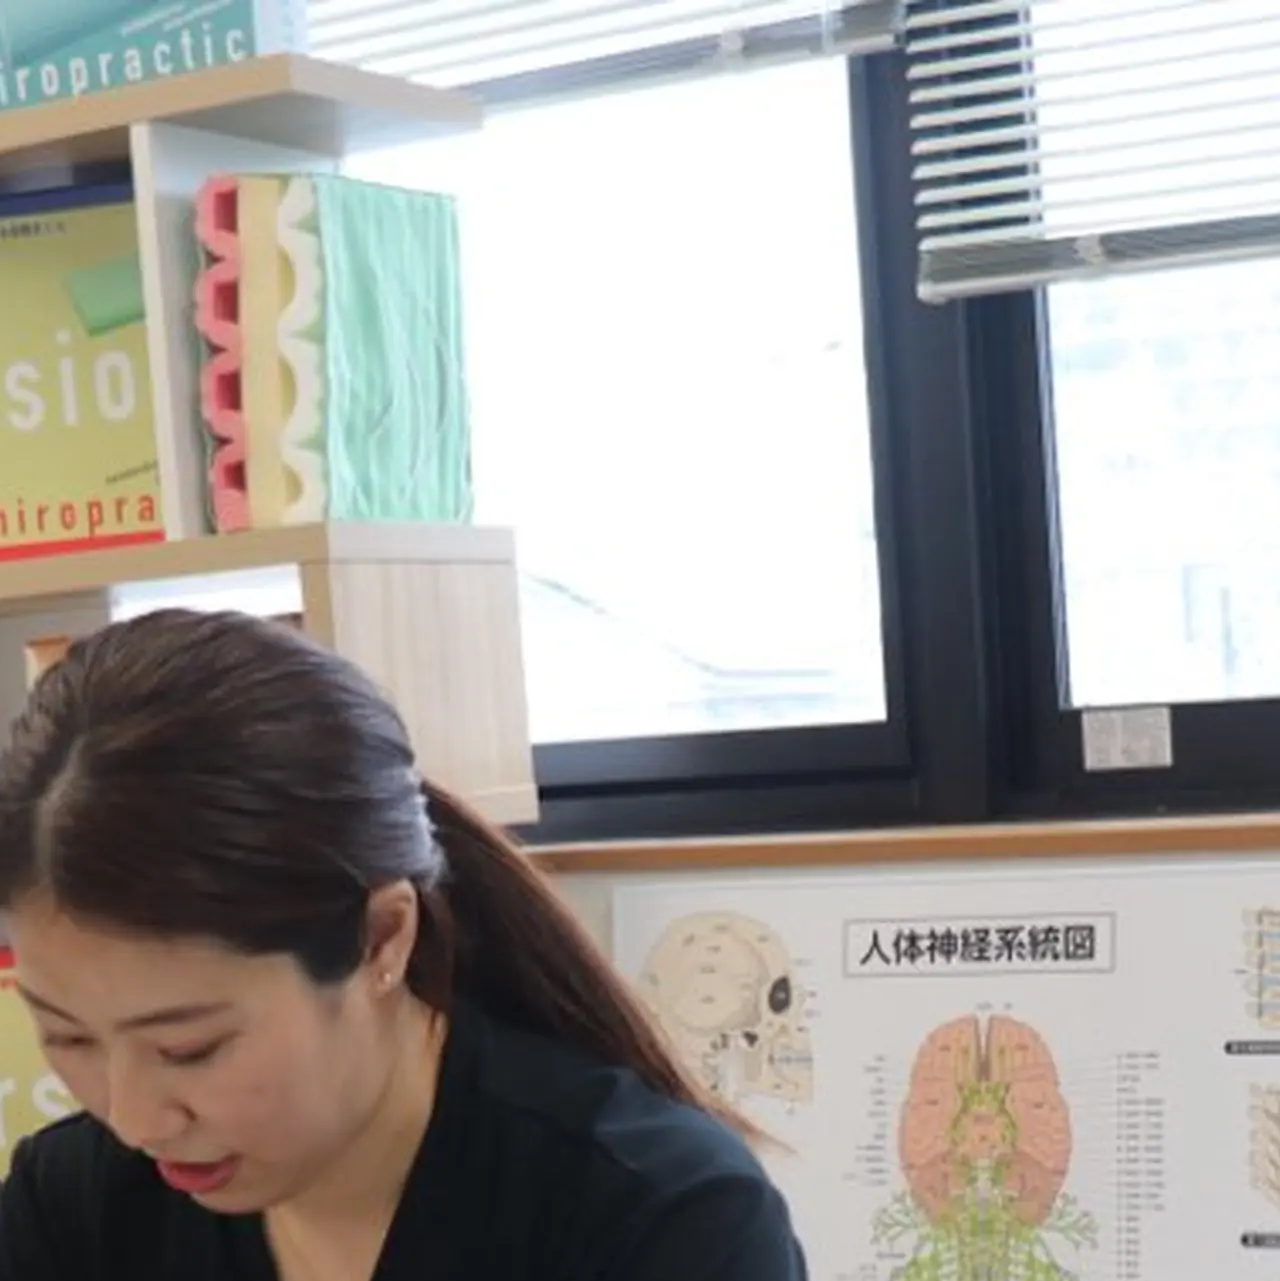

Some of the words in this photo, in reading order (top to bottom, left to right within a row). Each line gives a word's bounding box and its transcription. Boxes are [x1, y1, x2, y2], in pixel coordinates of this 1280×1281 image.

[859, 922, 1098, 966] 人体神経系統図
